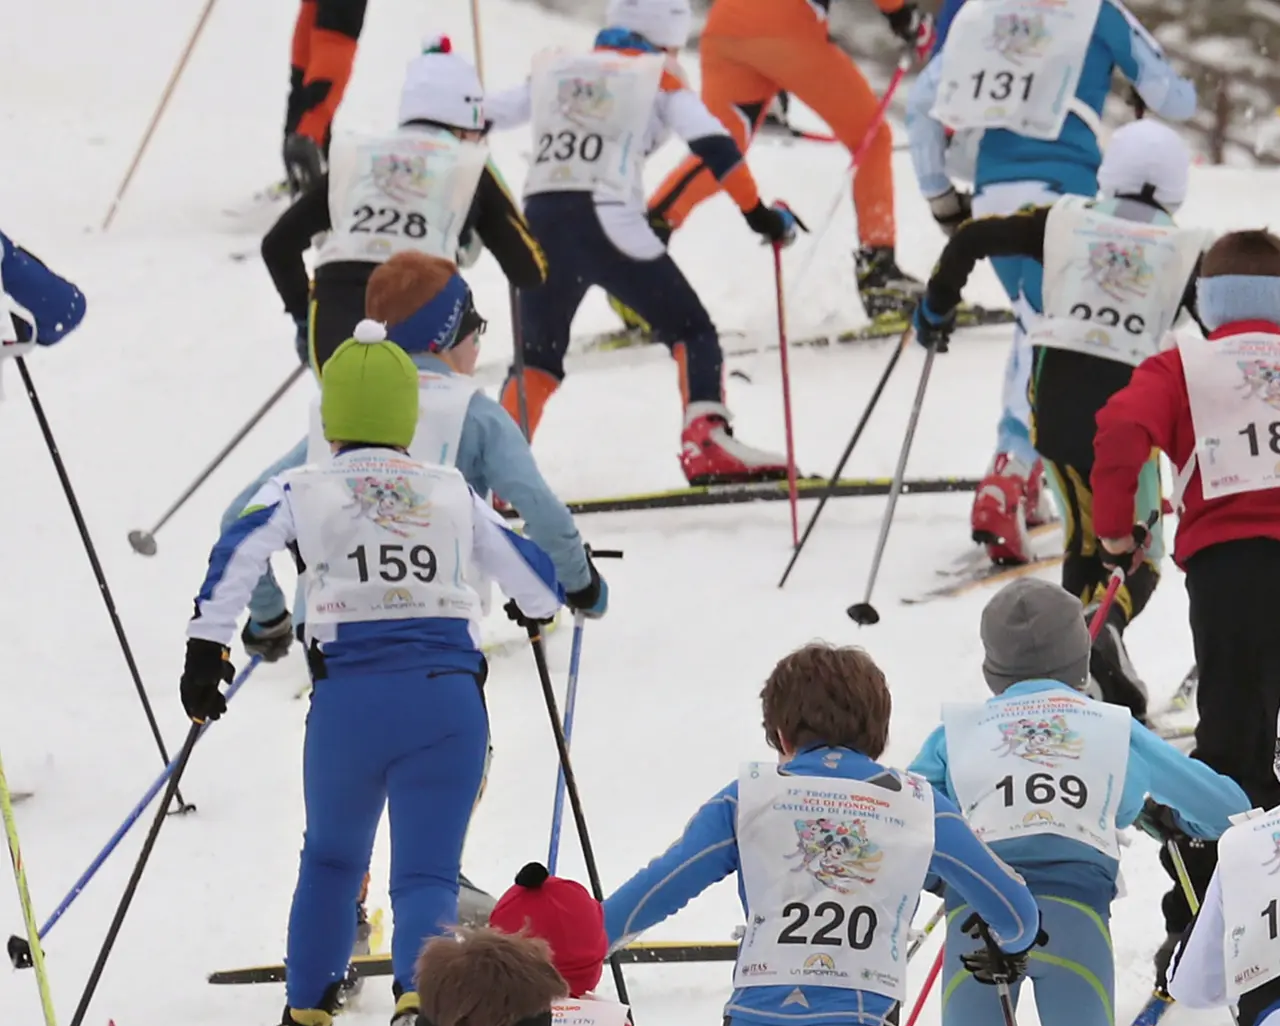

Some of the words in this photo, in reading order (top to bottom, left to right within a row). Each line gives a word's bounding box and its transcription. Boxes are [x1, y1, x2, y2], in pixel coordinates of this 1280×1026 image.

[971, 70, 1035, 102] 131
[536, 131, 603, 163] 230
[351, 205, 426, 238] 228
[347, 544, 437, 583] 159
[996, 773, 1087, 809] 169
[778, 902, 877, 949] 220
